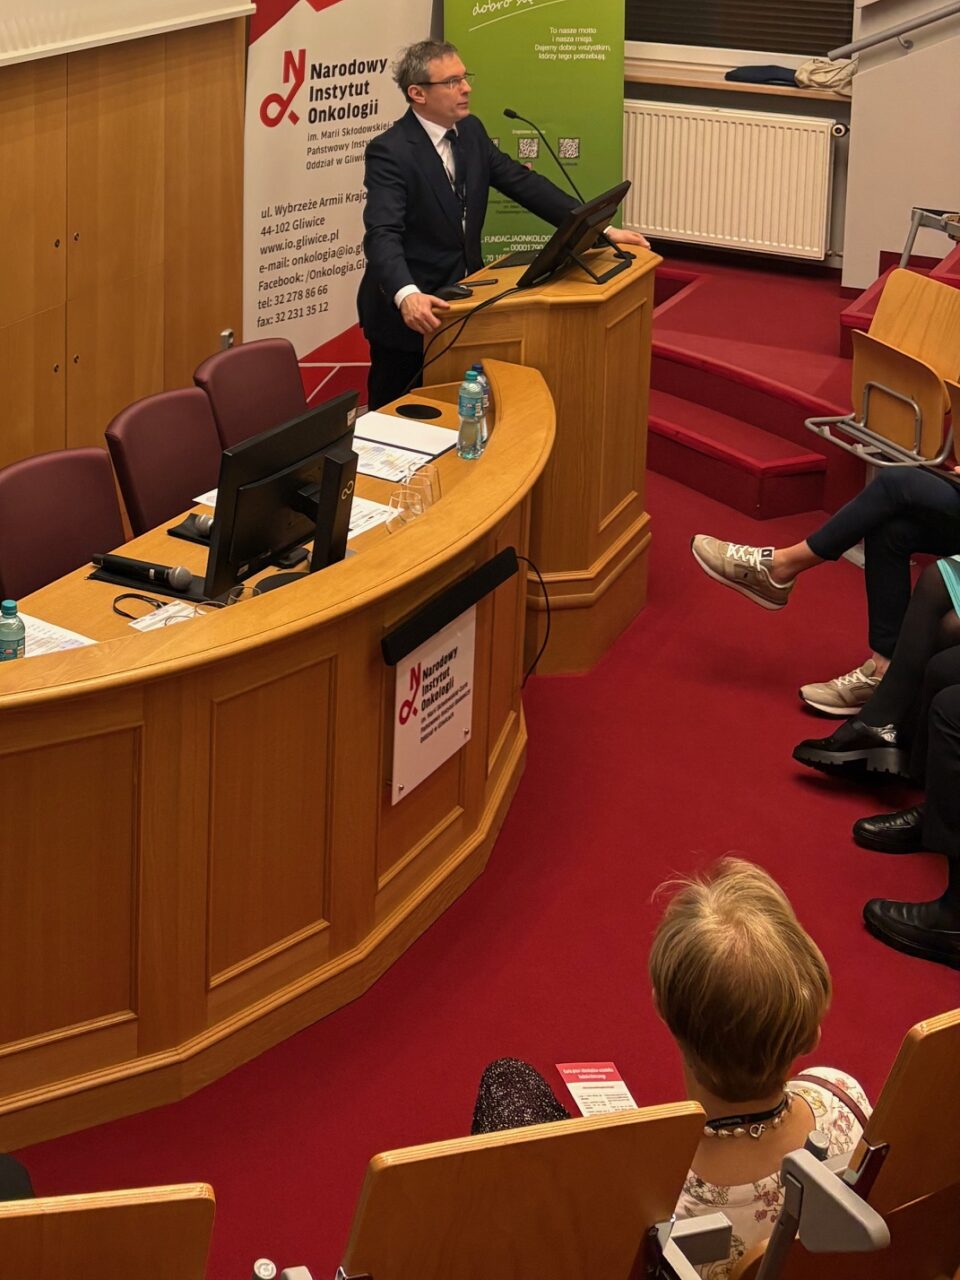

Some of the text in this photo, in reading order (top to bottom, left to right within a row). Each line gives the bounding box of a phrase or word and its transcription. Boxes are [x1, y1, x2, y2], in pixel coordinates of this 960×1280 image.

[472, 0, 512, 16] dobro
[310, 58, 388, 80] Narodowy
[309, 80, 370, 102] Instytut
[308, 99, 379, 124] Onkologii
[307, 133, 319, 142] im.
[321, 128, 340, 140] Marii
[307, 142, 349, 157] Państwowy
[306, 158, 334, 170] Oddział
[336, 157, 343, 165] w
[261, 208, 273, 219] ul.
[274, 198, 318, 217] Wybrzeże
[319, 193, 344, 209] Armii
[260, 215, 325, 237] 44-102 Gliwice
[260, 229, 339, 255] www.io.gliwice.pl
[259, 257, 290, 273] e-mail:
[258, 273, 304, 292] Facebook:
[258, 284, 328, 310] tel: 32 278 86 66
[257, 301, 329, 328] fax: 32 231 35 12
[422, 646, 458, 682] Narodowy
[422, 666, 450, 697] Instytut
[421, 675, 455, 712] Onkologii
